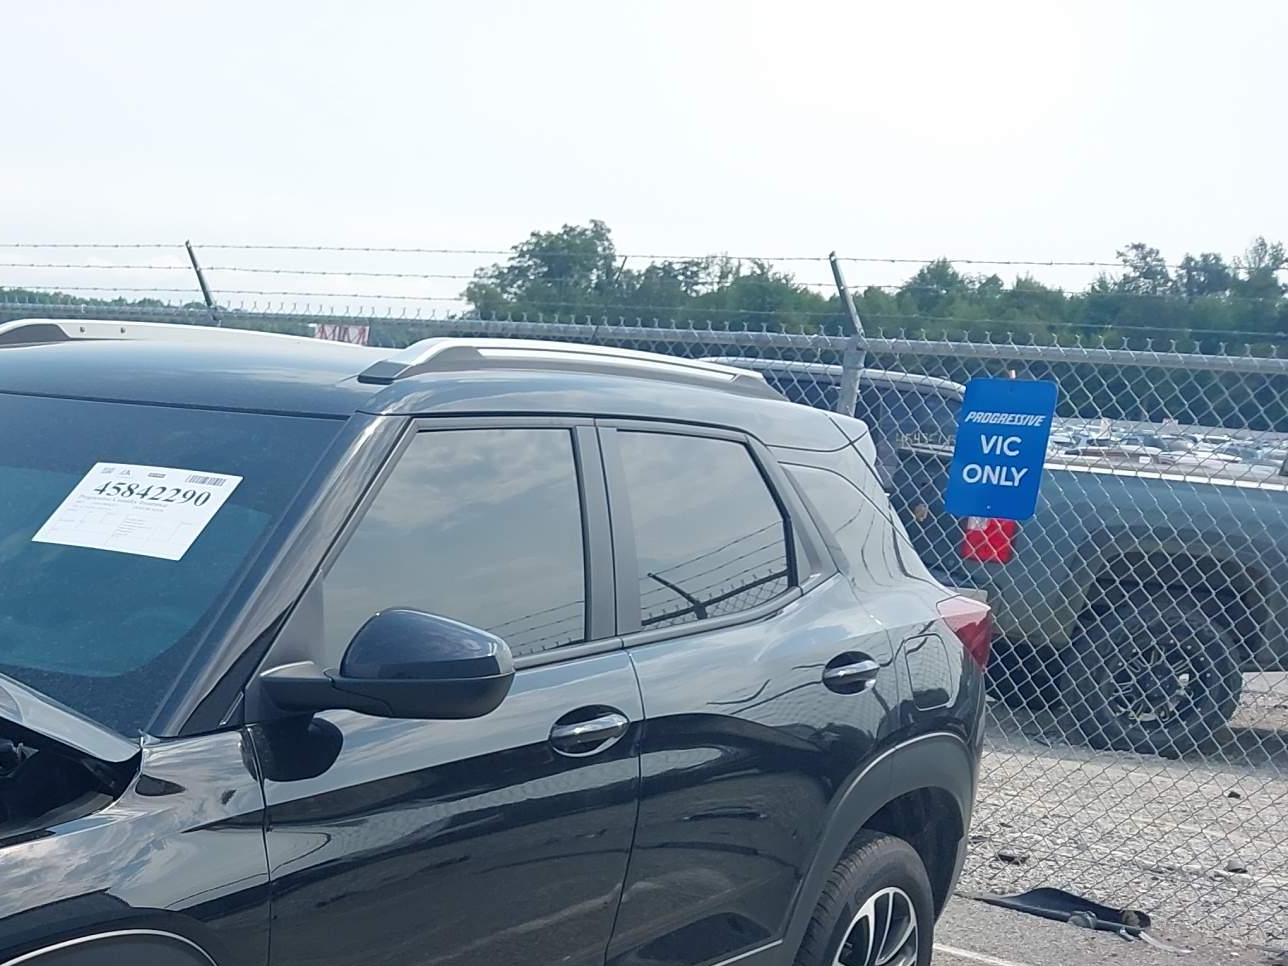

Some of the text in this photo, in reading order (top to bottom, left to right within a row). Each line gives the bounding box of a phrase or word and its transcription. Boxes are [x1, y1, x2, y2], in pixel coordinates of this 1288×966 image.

[964, 411, 1046, 427] PROGRESSIVE
[980, 434, 1022, 457] VIC
[962, 464, 1028, 487] ONLY
[93, 480, 212, 507] 45842290
